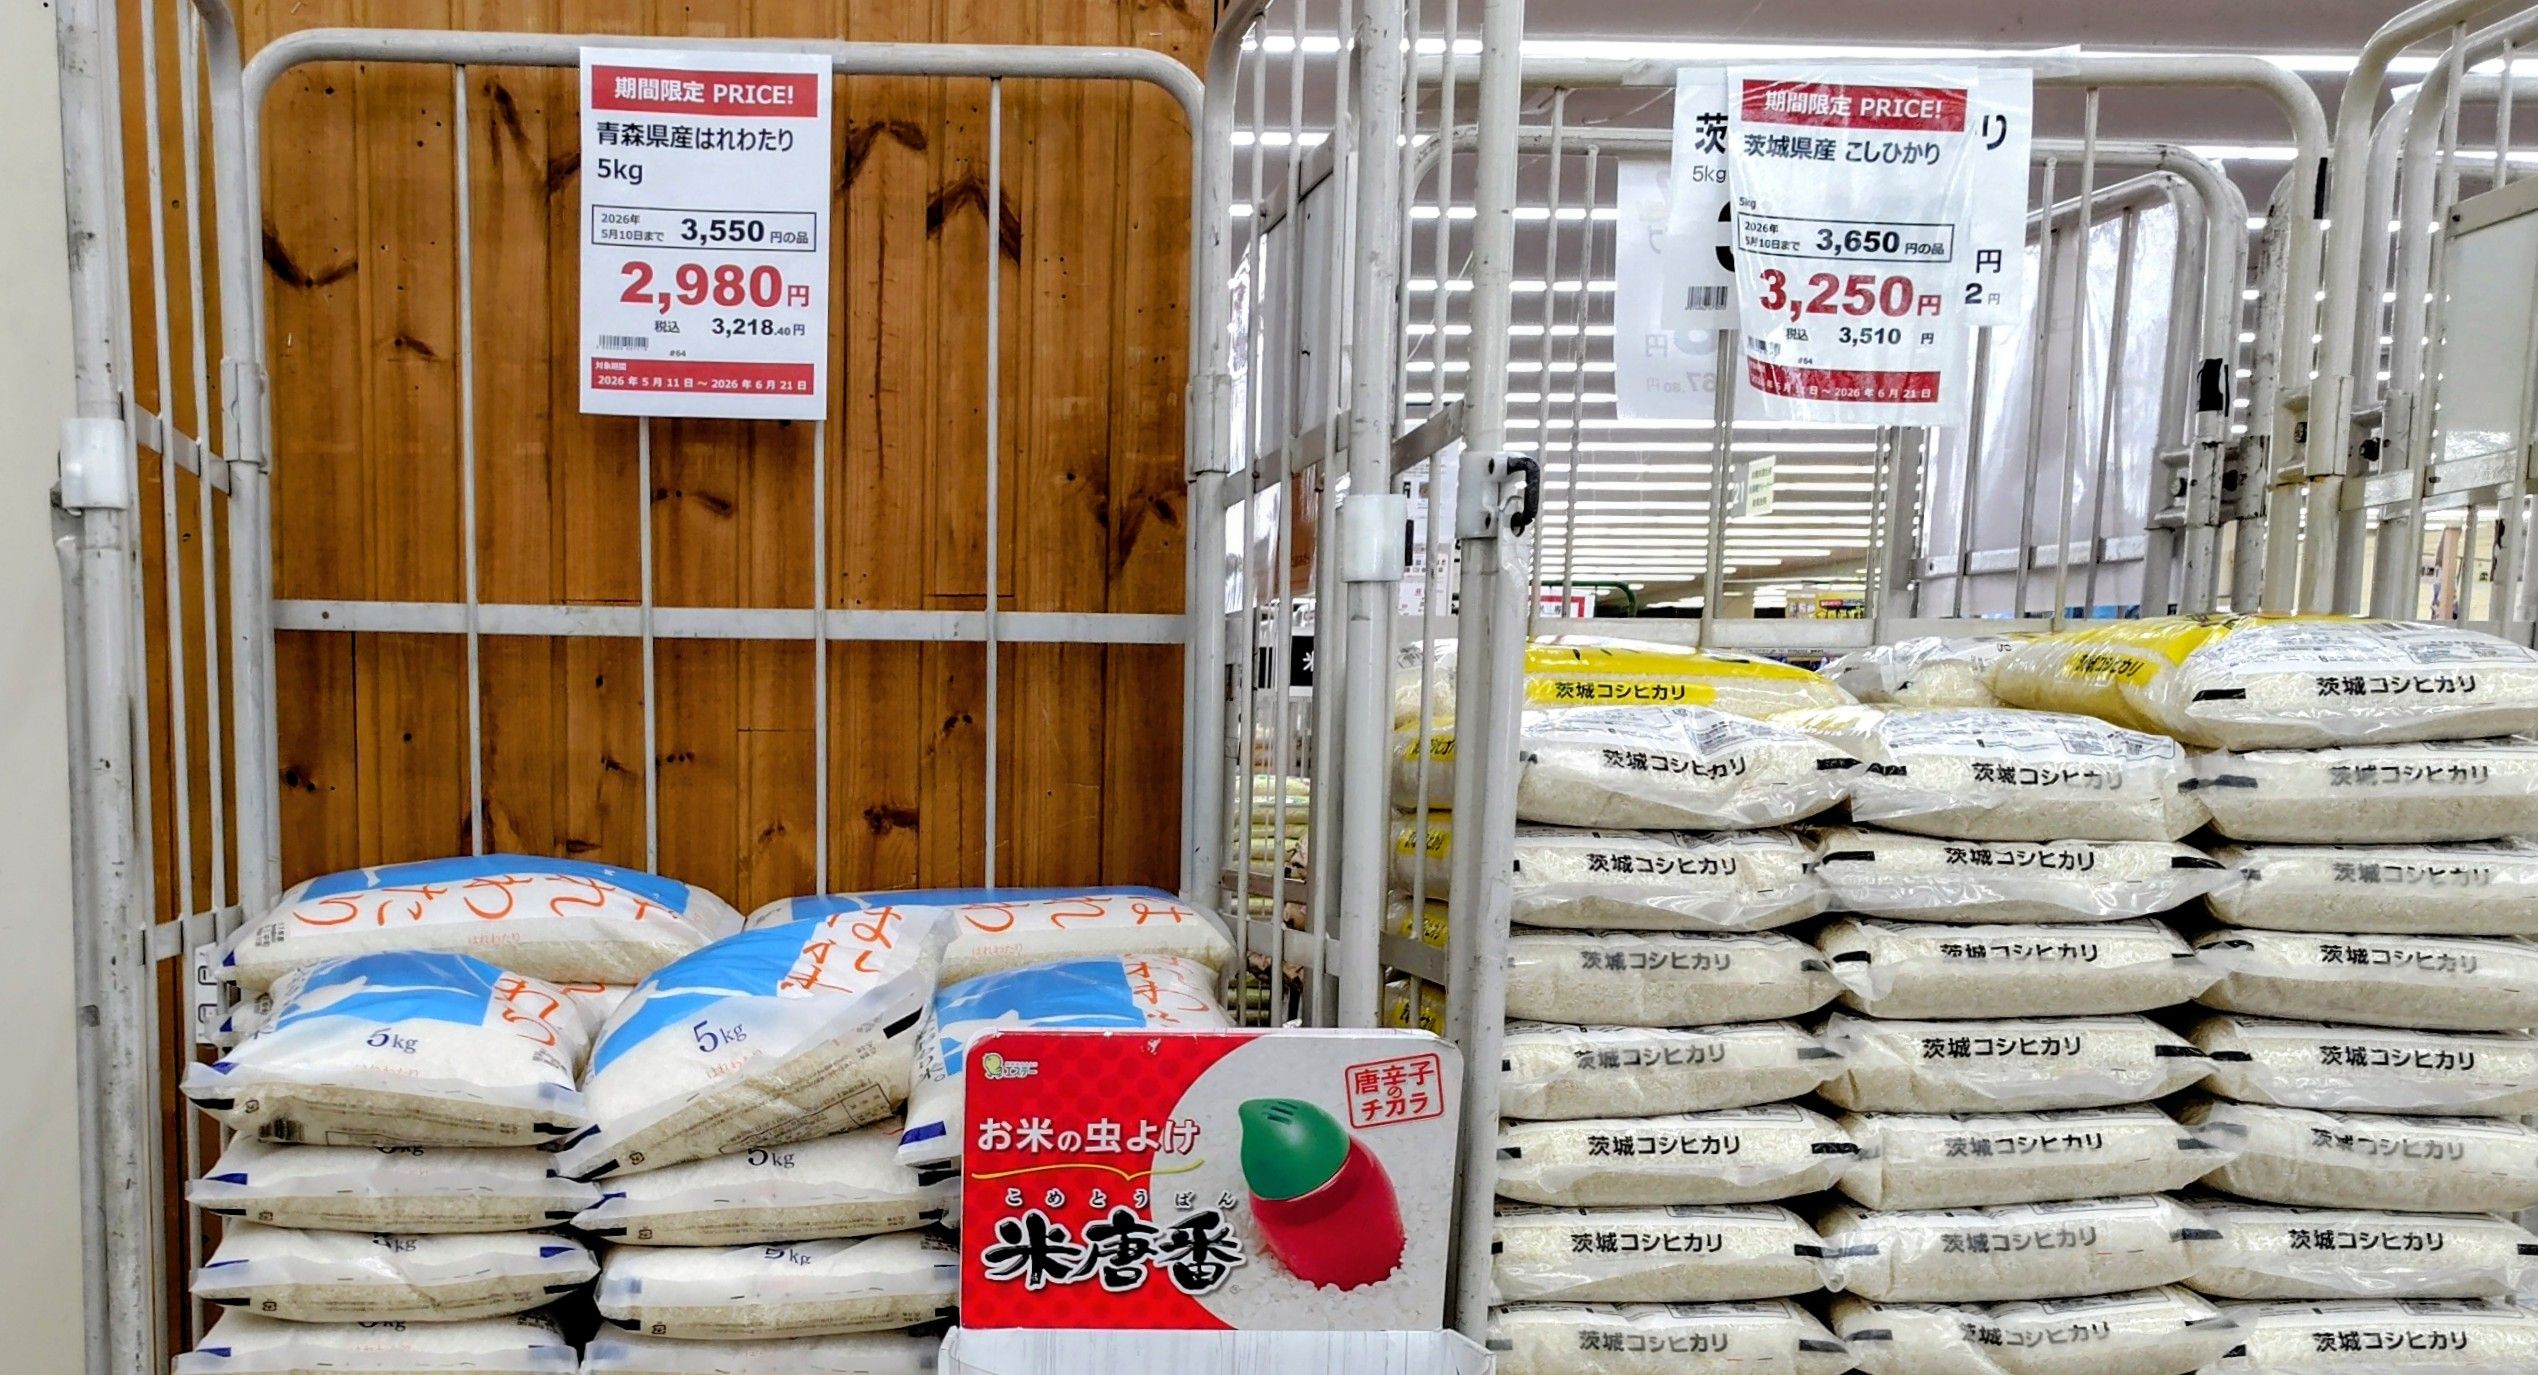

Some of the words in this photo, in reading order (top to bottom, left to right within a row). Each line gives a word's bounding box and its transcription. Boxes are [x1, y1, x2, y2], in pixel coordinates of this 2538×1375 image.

[614, 76, 705, 103] 期間限定
[713, 83, 794, 105] PRICE!
[1764, 90, 1851, 117] 期間限定
[1860, 99, 1942, 119] PRICE!
[597, 121, 794, 152] 青森県産はれわたり
[1743, 134, 1836, 161] 茨城県産
[1846, 140, 1941, 165] こしひかり
[597, 158, 643, 185] 5kg
[1692, 164, 1727, 183] 5kg
[601, 212, 641, 225] 2026年
[1745, 221, 1779, 234] 2026年
[601, 229, 664, 242] 5月10日まで
[681, 217, 765, 246] 3,550
[770, 230, 809, 244] 円の品
[1816, 228, 1900, 256] 3,650
[1904, 242, 1945, 255] 円の品
[654, 320, 681, 334] 税込
[1786, 327, 1809, 342] 税込
[1839, 327, 1901, 347] 3,510
[1921, 332, 1934, 345] 円
[1555, 682, 1687, 701] 茨城コシヒカリ
[2316, 675, 2476, 696] 茨城コシヒカリ
[1603, 749, 1746, 779] 茨城コシヒカリ
[1972, 762, 2123, 790] 茨城コシヒカリ
[2329, 765, 2490, 786] 茨城コシヒカリ
[1586, 853, 1737, 876] 茨城コシヒカリ
[1945, 848, 2095, 872] 茨城コシヒカリ
[2334, 862, 2491, 887] 茨城コシヒカリ
[1580, 950, 1732, 971] 茨城コシヒカリ
[2321, 944, 2479, 973] 茨城コシヒカリ
[693, 1020, 747, 1053] 5kg
[1922, 1037, 2081, 1058] 茨城コシヒカリ
[1575, 1043, 1727, 1069] 茨城コシヒカリ
[2320, 1046, 2475, 1071] 茨城コシヒカリ
[1355, 1061, 1434, 1095] 唐辛子
[1387, 1086, 1402, 1098] の
[1361, 1092, 1428, 1121] チカラ
[977, 1117, 1200, 1154] お米の虫よけ
[1587, 1134, 1742, 1157] 茨城コシヒカリ
[1944, 1132, 2103, 1158] 茨城コシヒカリ
[2311, 1128, 2466, 1160] 茨城コシヒカリ
[984, 1208, 1243, 1290] 米唐番
[1571, 1232, 1724, 1253] 茨城コシヒカリ
[1941, 1226, 2097, 1253] 茨城コシヒカリ
[2289, 1228, 2444, 1251] 茨城コシヒカリ
[1578, 1331, 1730, 1352] 茨城コシヒカリ
[1960, 1321, 2111, 1348] 茨城コシヒカリ
[2313, 1331, 2468, 1352] 茨城コシヒカリ
